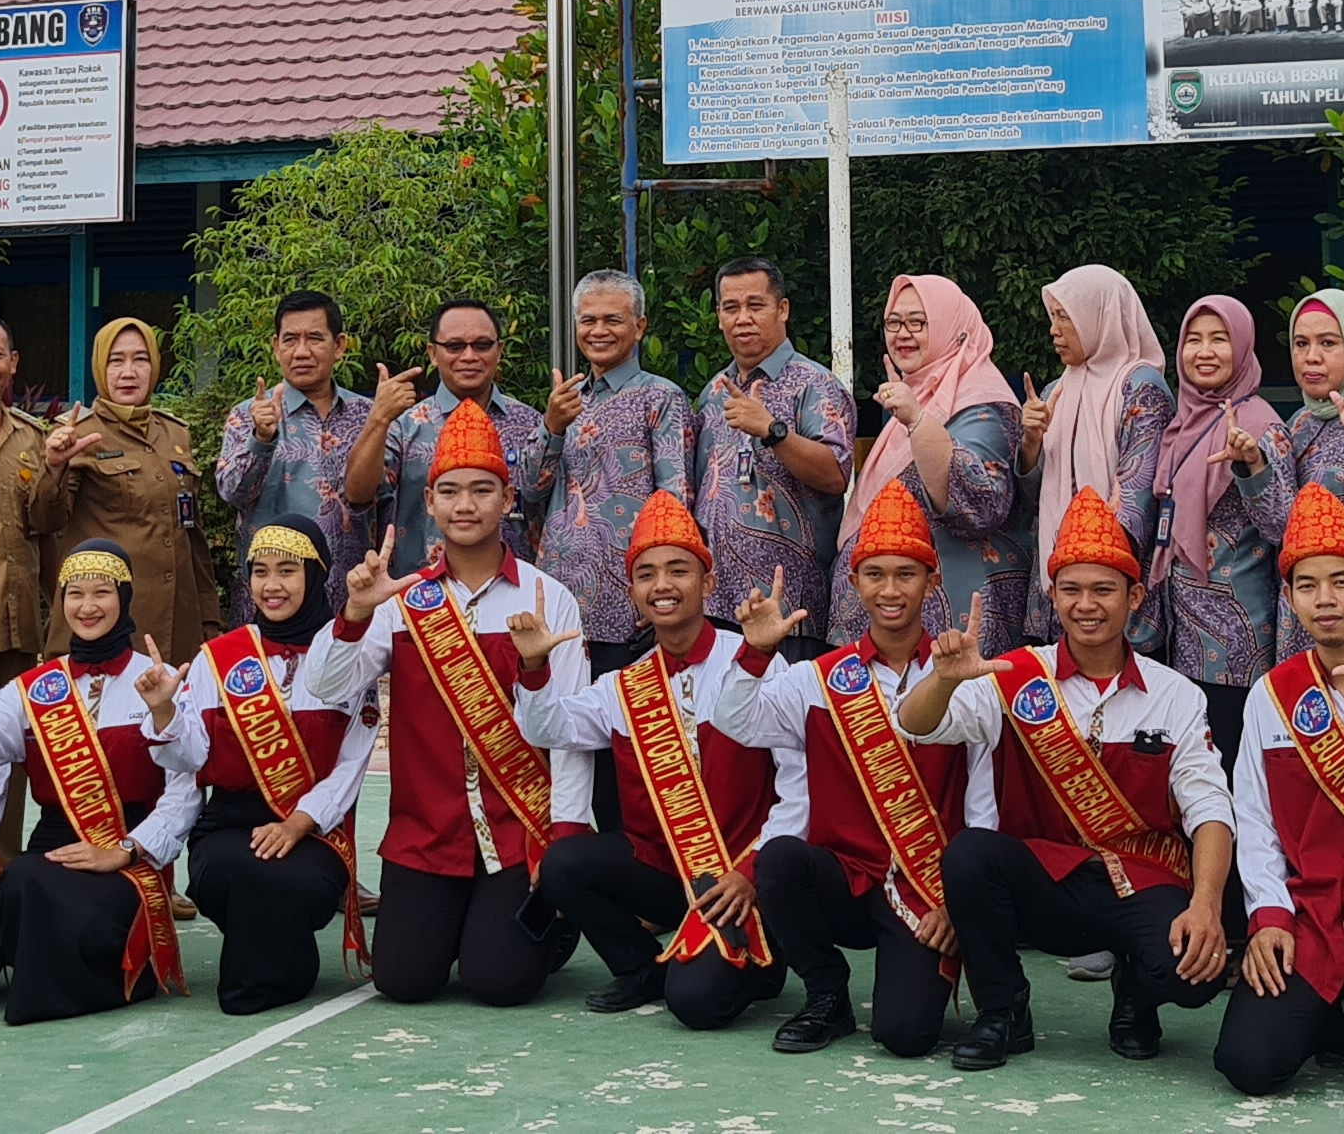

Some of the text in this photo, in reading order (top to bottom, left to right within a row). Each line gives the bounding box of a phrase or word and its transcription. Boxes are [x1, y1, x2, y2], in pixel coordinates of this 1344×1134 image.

[735, 0, 884, 17] BERWAWASAN LINGKUNGAN
[876, 12, 907, 24] MISI
[700, 36, 769, 49] Meningkatkan
[772, 32, 835, 45] Pengamalan
[837, 31, 874, 42] Agama
[877, 28, 908, 39] Sesuai
[912, 28, 951, 38] Dengan
[954, 23, 1024, 36] Kepercayaan
[1026, 18, 1106, 31] Masing-masing
[700, 52, 743, 63] Mentaati
[745, 52, 778, 61] Semua
[782, 48, 828, 59] Peraturan
[831, 46, 870, 56] Sekolah
[873, 45, 912, 55] Dengan
[915, 41, 975, 53] Menjadikan
[978, 39, 1016, 48] Tenaga
[1019, 36, 1063, 46] Pendidik
[18, 69, 52, 77] Kawasan
[78, 64, 102, 74] Rokok
[700, 67, 767, 78] Kependidikan
[770, 63, 811, 75] Sebagai
[856, 74, 893, 85] Rangka
[896, 70, 968, 83] Meningkatkan
[972, 67, 1050, 78] Profesionalisme
[1208, 70, 1286, 87] KELUARGA
[1290, 67, 1339, 82] BESAR
[701, 82, 772, 92] Melaksanakan
[775, 78, 817, 90] Supervisi
[701, 96, 771, 108] Meningkatkan
[880, 88, 911, 97] Dalam
[915, 86, 959, 97] Mengola
[962, 82, 1033, 94] Pembelajaran
[1036, 81, 1063, 92] Yang
[1260, 89, 1310, 105] TAHUN
[701, 109, 784, 122] Efektif Dan Efisien
[889, 116, 959, 128] Pembelajaran
[962, 115, 997, 124] Secara
[1001, 110, 1100, 122] Berkesinambungan
[701, 126, 773, 136] Melaksanakan
[777, 122, 821, 133] Penilaian
[934, 131, 964, 140] Aman
[968, 129, 987, 138] Dan
[991, 128, 1020, 137] Indah
[701, 140, 759, 151] Memelihara
[763, 137, 819, 148] Lingkungan
[418, 607, 466, 660] BUJANG
[440, 650, 503, 730] LINGKUNGAN
[39, 703, 86, 754] GADIS
[236, 694, 289, 760] GADIS
[478, 719, 521, 762] SMAN
[622, 658, 708, 836] BUJANG FAVORIT SMAN 12
[497, 750, 524, 775] 12
[56, 745, 112, 821] FAVORIT
[840, 690, 937, 860] WAKIL BUJANG SMAN 12
[1029, 718, 1086, 777] BUJANG
[1060, 767, 1136, 839] BERBAKAT
